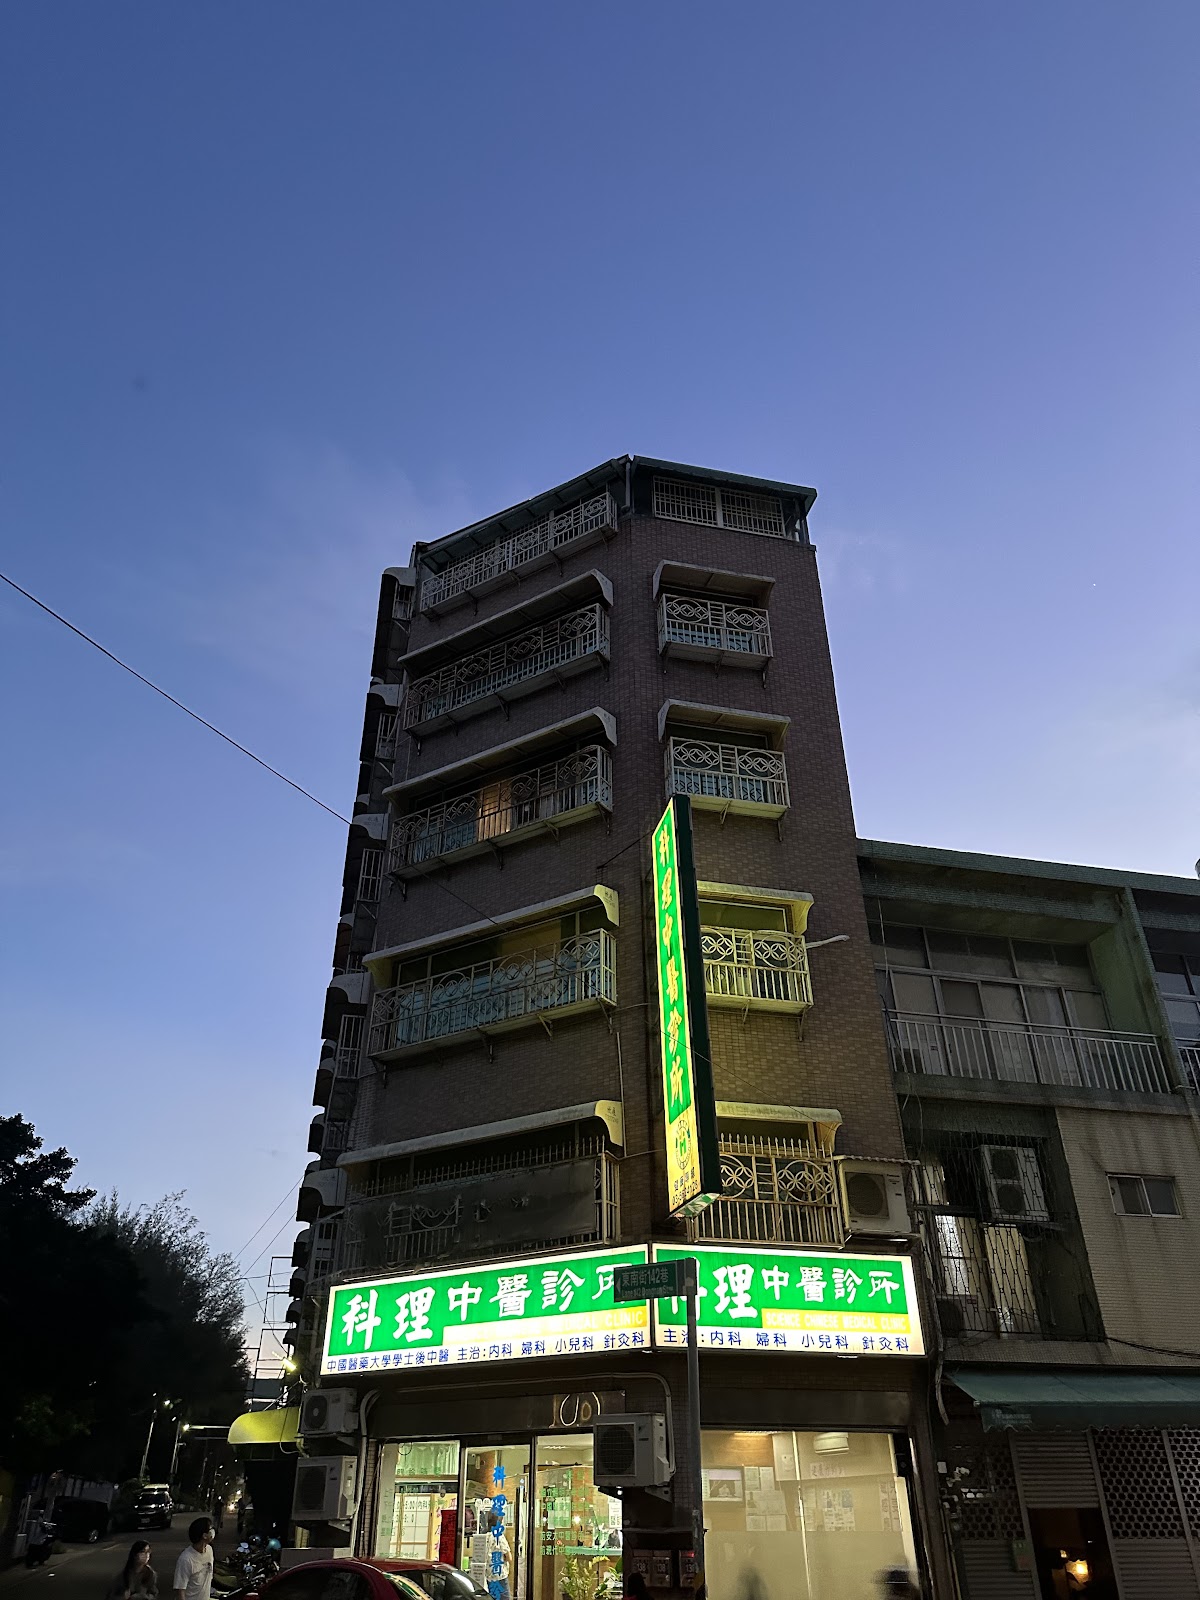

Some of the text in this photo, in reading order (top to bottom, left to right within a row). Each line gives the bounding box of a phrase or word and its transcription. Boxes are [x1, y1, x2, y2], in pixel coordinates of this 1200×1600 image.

[659, 824, 683, 1107] 科理中醫診所
[621, 1268, 669, 1287] 東南街142巷
[604, 1310, 644, 1327] CLINIC
[766, 1312, 906, 1331] SCIENCE CHINESE MEDICAL CLINIC
[756, 1331, 787, 1347] 婦科
[801, 1333, 849, 1350] 小兒科
[862, 1335, 909, 1351] 針灸科
[327, 1347, 449, 1372] 中國醫藥大學學士後中醫
[521, 1338, 546, 1355] 婦科
[555, 1335, 594, 1352] 小兒科
[604, 1331, 645, 1348] 針灸科
